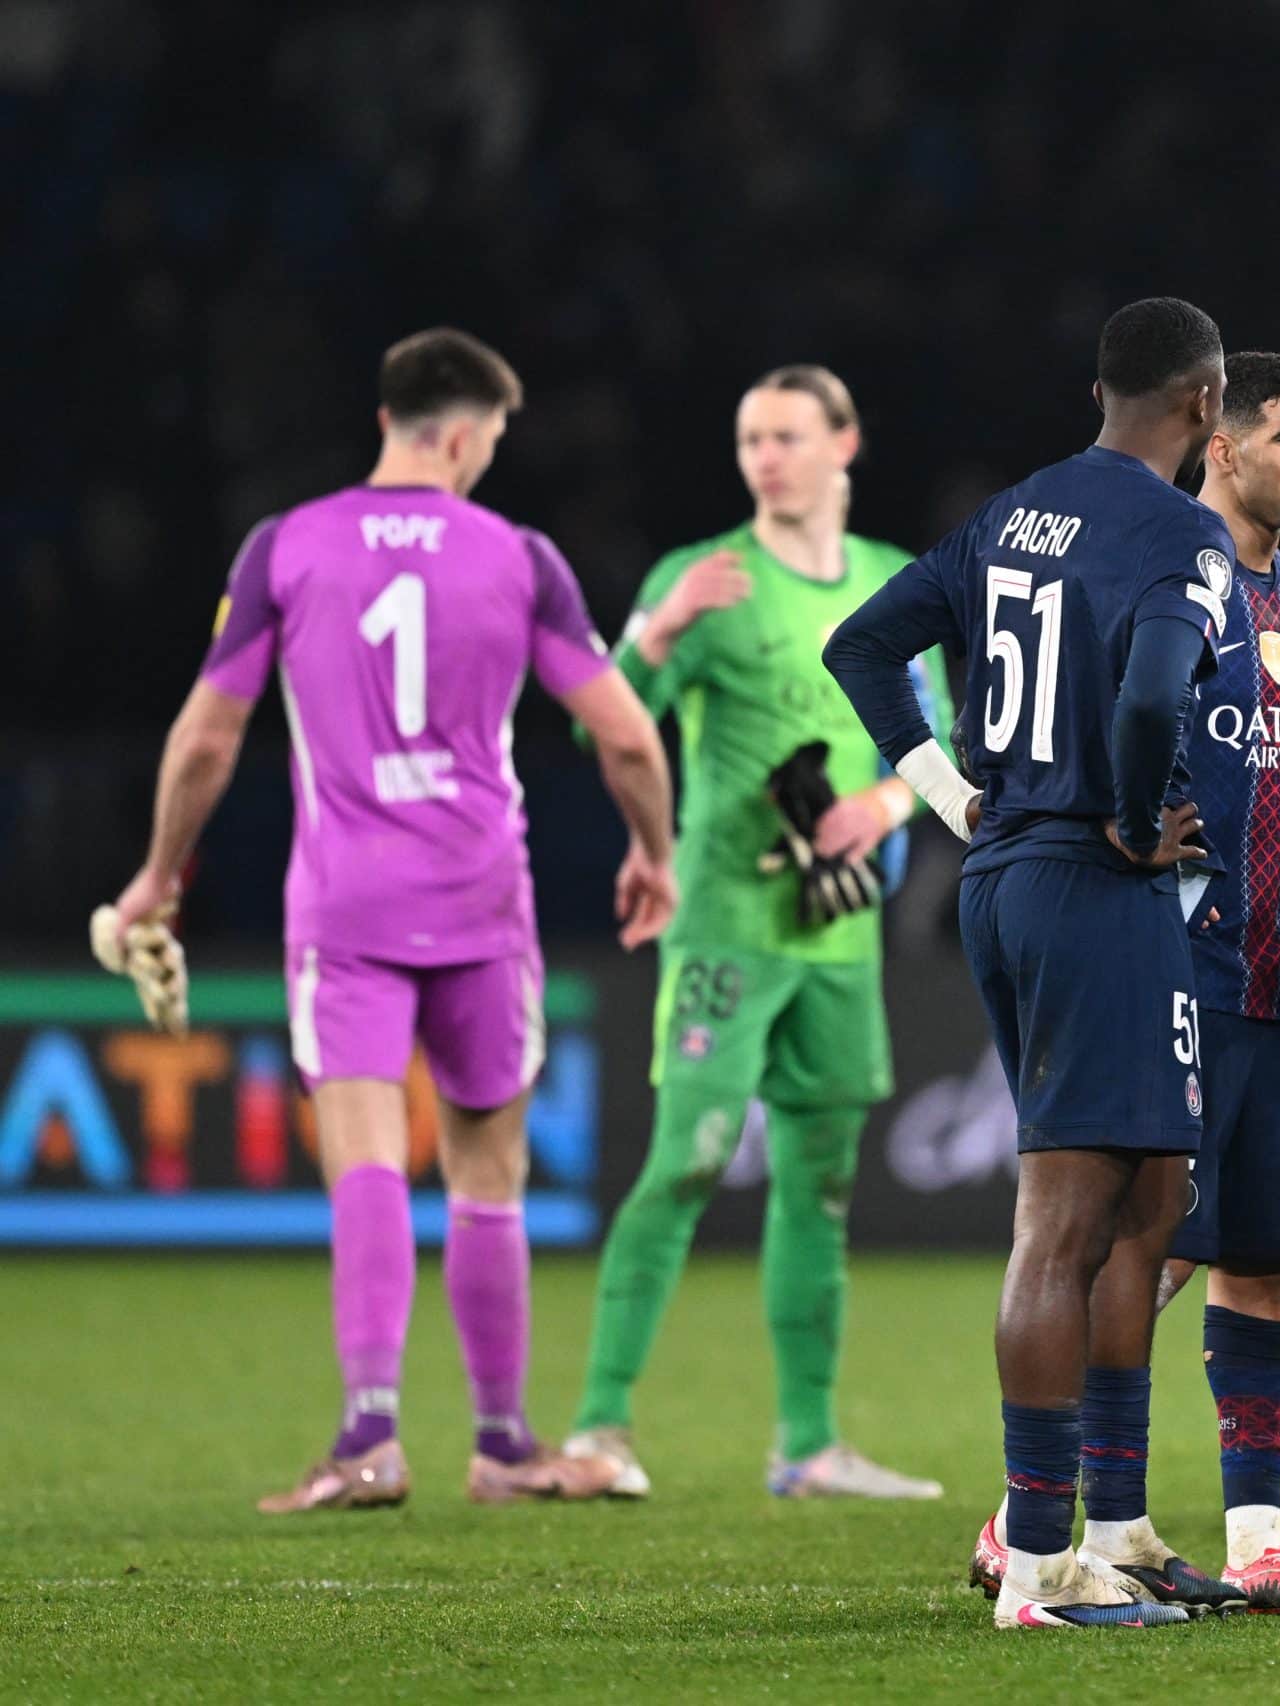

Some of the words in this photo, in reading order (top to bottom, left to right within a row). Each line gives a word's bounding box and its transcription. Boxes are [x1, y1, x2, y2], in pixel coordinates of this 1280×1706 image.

[359, 513, 448, 552] POPE
[998, 507, 1082, 557] PACHO
[358, 572, 427, 738] 1
[984, 565, 1063, 763] 51
[1172, 990, 1201, 1069] 51
